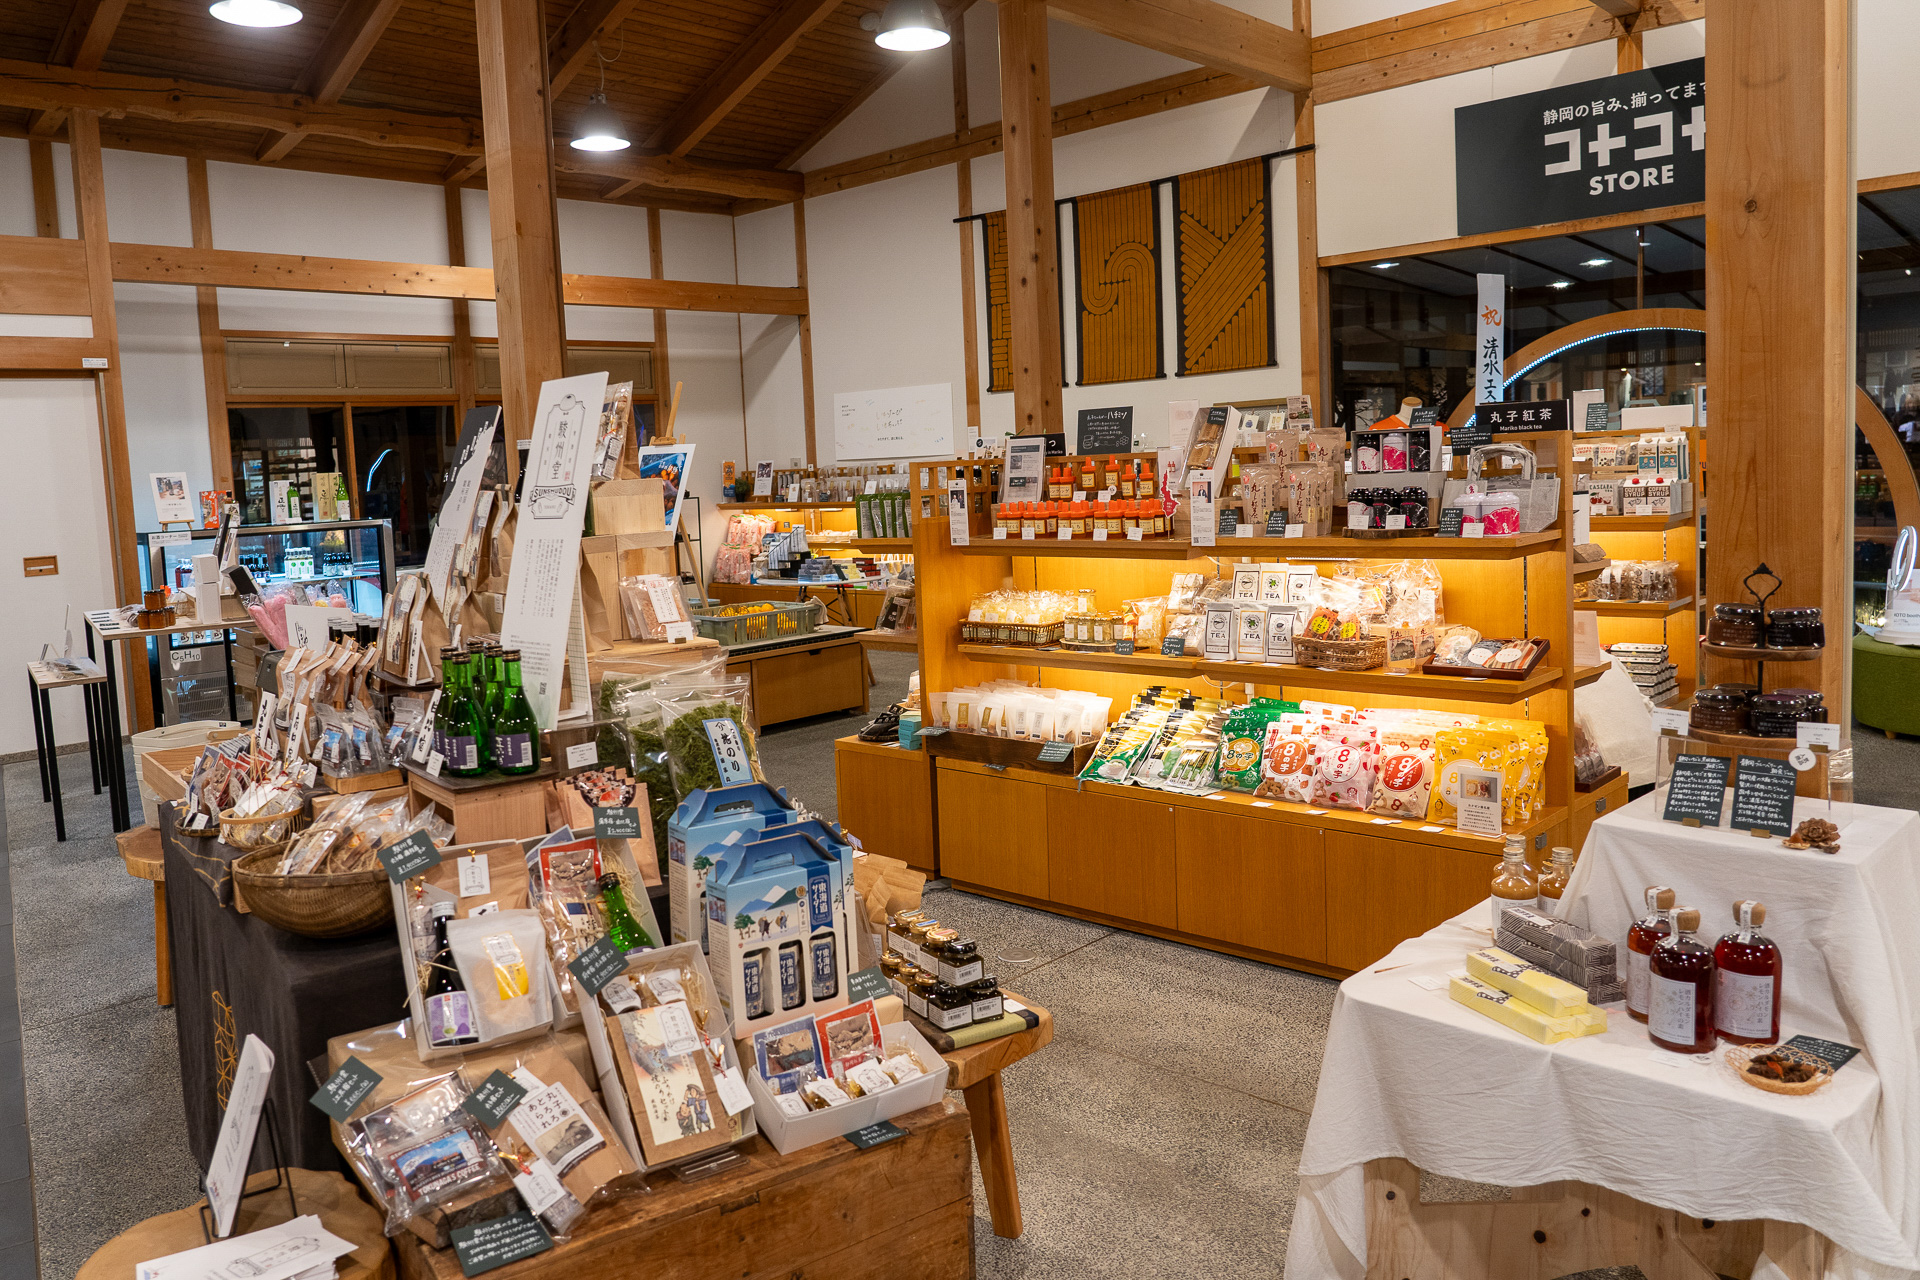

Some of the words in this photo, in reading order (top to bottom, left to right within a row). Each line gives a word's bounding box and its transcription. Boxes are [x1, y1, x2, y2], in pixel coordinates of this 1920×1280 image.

[1589, 164, 1674, 196] STORE
[1481, 305, 1502, 326] 祝
[1482, 336, 1502, 404] 清水エス
[1490, 408, 1552, 423] 丸子紅茶
[533, 486, 572, 499] SUNSHUDOU
[1226, 749, 1255, 761] 8の字
[1279, 742, 1297, 773] 8の字
[1332, 748, 1350, 779] 8の字
[819, 882, 828, 913] 東海道
[786, 960, 795, 990] 東海道
[822, 949, 831, 975] 東海道
[751, 967, 760, 994] 東海道
[537, 1098, 560, 1123] とろろ
[546, 1091, 563, 1110] 丸子
[528, 1102, 552, 1130] あられ
[455, 1164, 482, 1184] COFFEE
